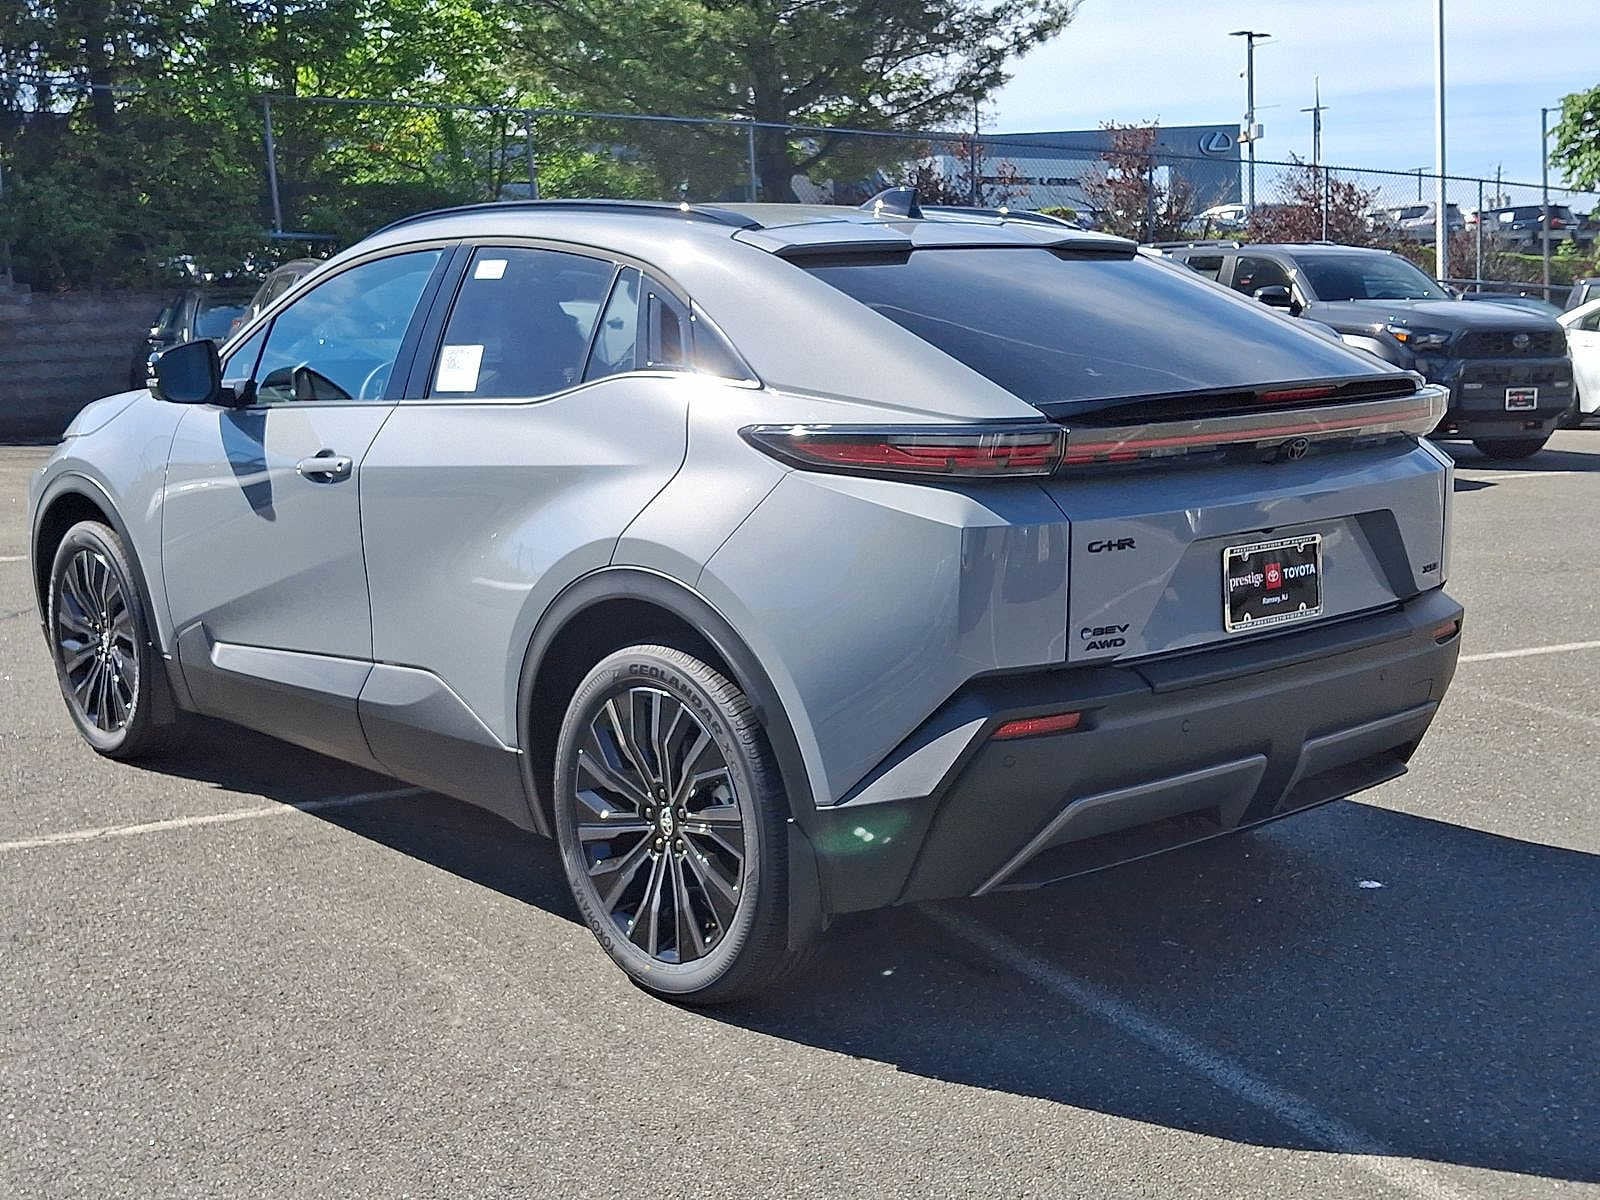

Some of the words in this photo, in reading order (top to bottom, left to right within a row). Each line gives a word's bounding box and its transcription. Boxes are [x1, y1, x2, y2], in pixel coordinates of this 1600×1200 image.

[1229, 572, 1264, 592] prestige
[1283, 563, 1316, 579] TOYOTA
[1085, 638, 1126, 652] AWD
[628, 663, 724, 735] GEOLANDAR
[573, 878, 617, 957] YOKOHAMA
